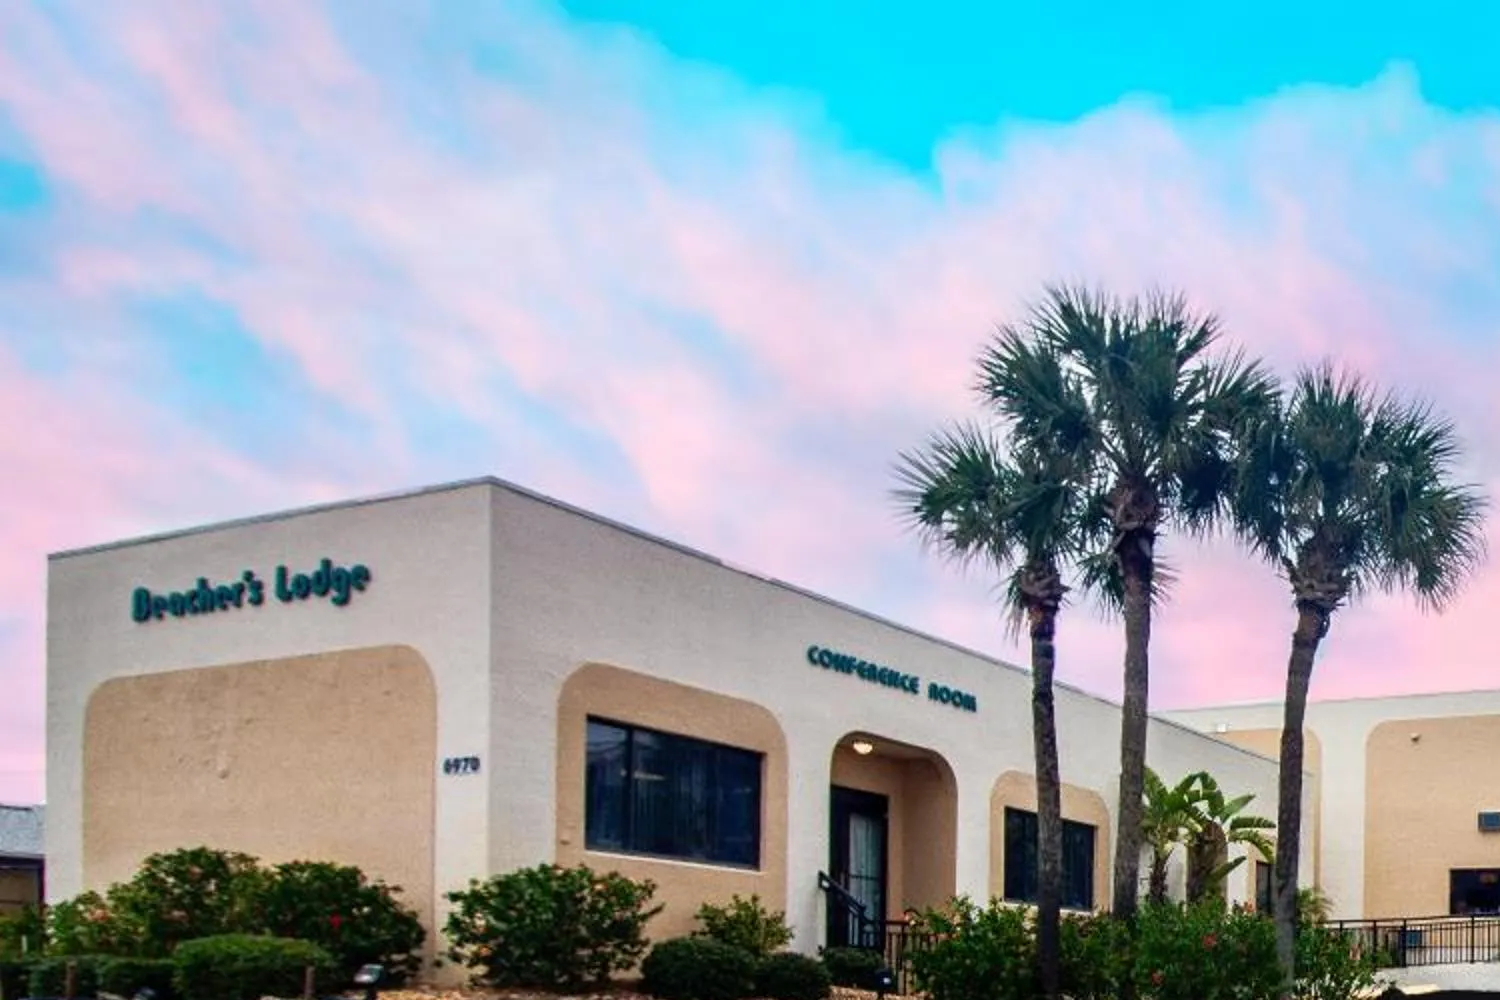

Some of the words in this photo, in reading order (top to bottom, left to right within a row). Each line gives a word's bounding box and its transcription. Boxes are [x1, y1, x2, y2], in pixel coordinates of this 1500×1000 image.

[131, 569, 265, 622] Beacher's
[275, 557, 371, 606] Lodge
[807, 645, 920, 694] CONFERENCE
[929, 682, 977, 712] ROOM
